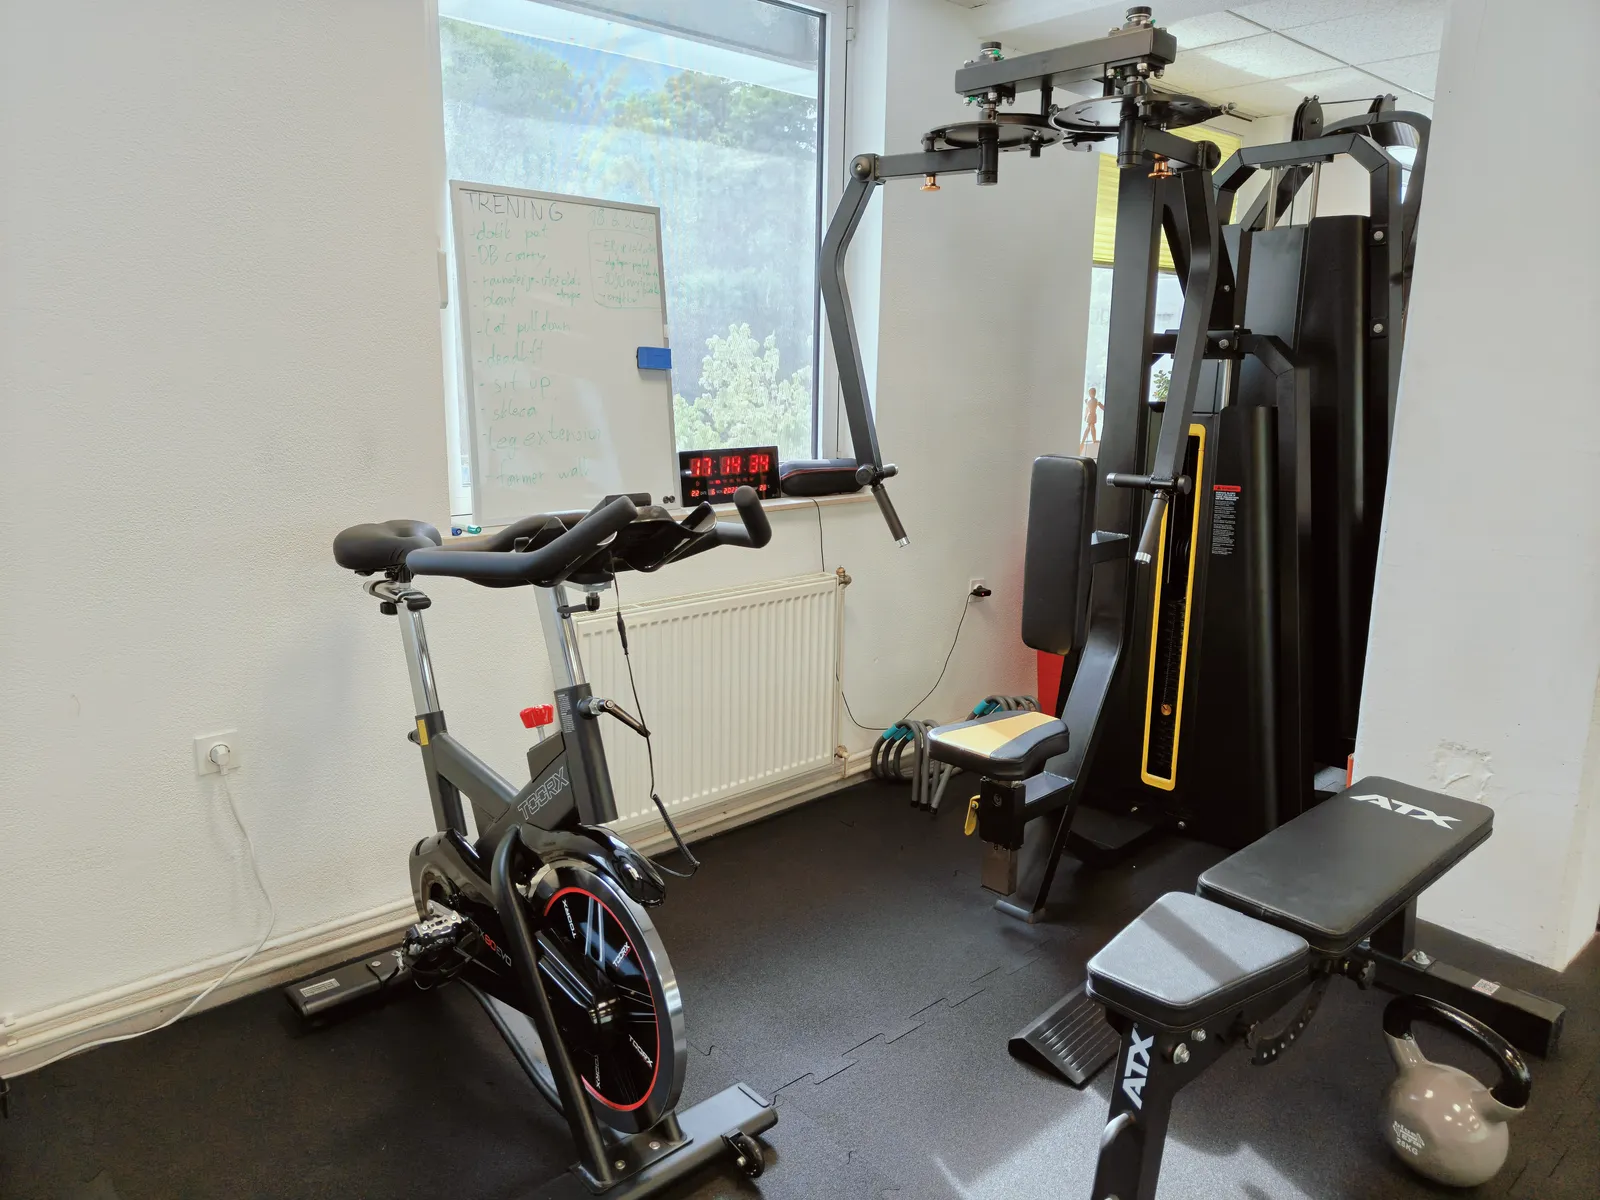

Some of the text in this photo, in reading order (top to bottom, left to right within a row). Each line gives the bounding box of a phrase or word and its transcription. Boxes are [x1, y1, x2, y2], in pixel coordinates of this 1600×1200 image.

[465, 191, 564, 222] TRENING
[477, 244, 499, 266] DB
[486, 339, 544, 369] deadlift
[493, 371, 551, 399] sit up
[691, 489, 700, 497] 22
[1349, 794, 1462, 830] ATX
[612, 941, 631, 967] TOORX
[628, 1034, 654, 1068] TOORX
[1122, 1026, 1155, 1110] ATX
